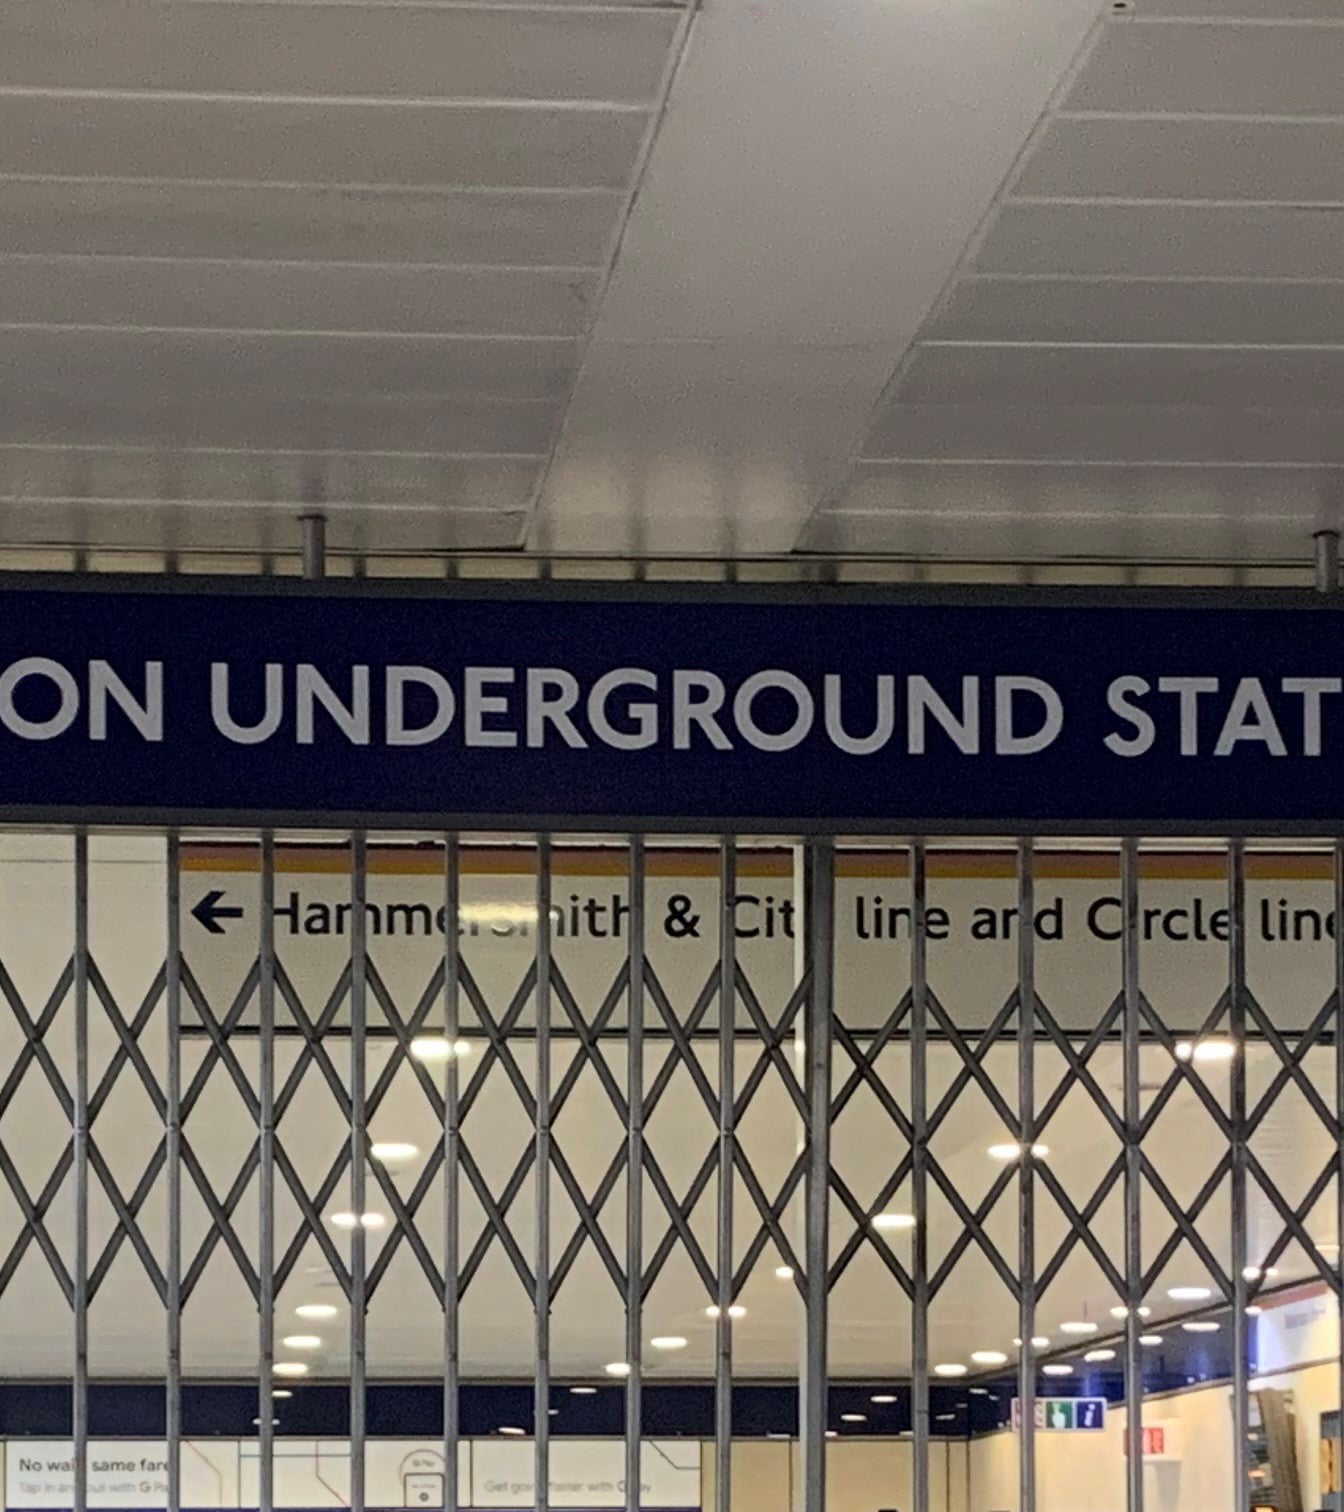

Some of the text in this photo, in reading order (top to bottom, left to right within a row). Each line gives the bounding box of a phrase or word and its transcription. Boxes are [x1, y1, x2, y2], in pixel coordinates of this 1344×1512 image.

[210, 661, 1065, 756] UNDERGROUND
[663, 894, 701, 939] &
[728, 894, 795, 939] Cit
[855, 896, 950, 940] line
[1087, 896, 1232, 941] Crcle
[46, 1458, 77, 1473] wai
